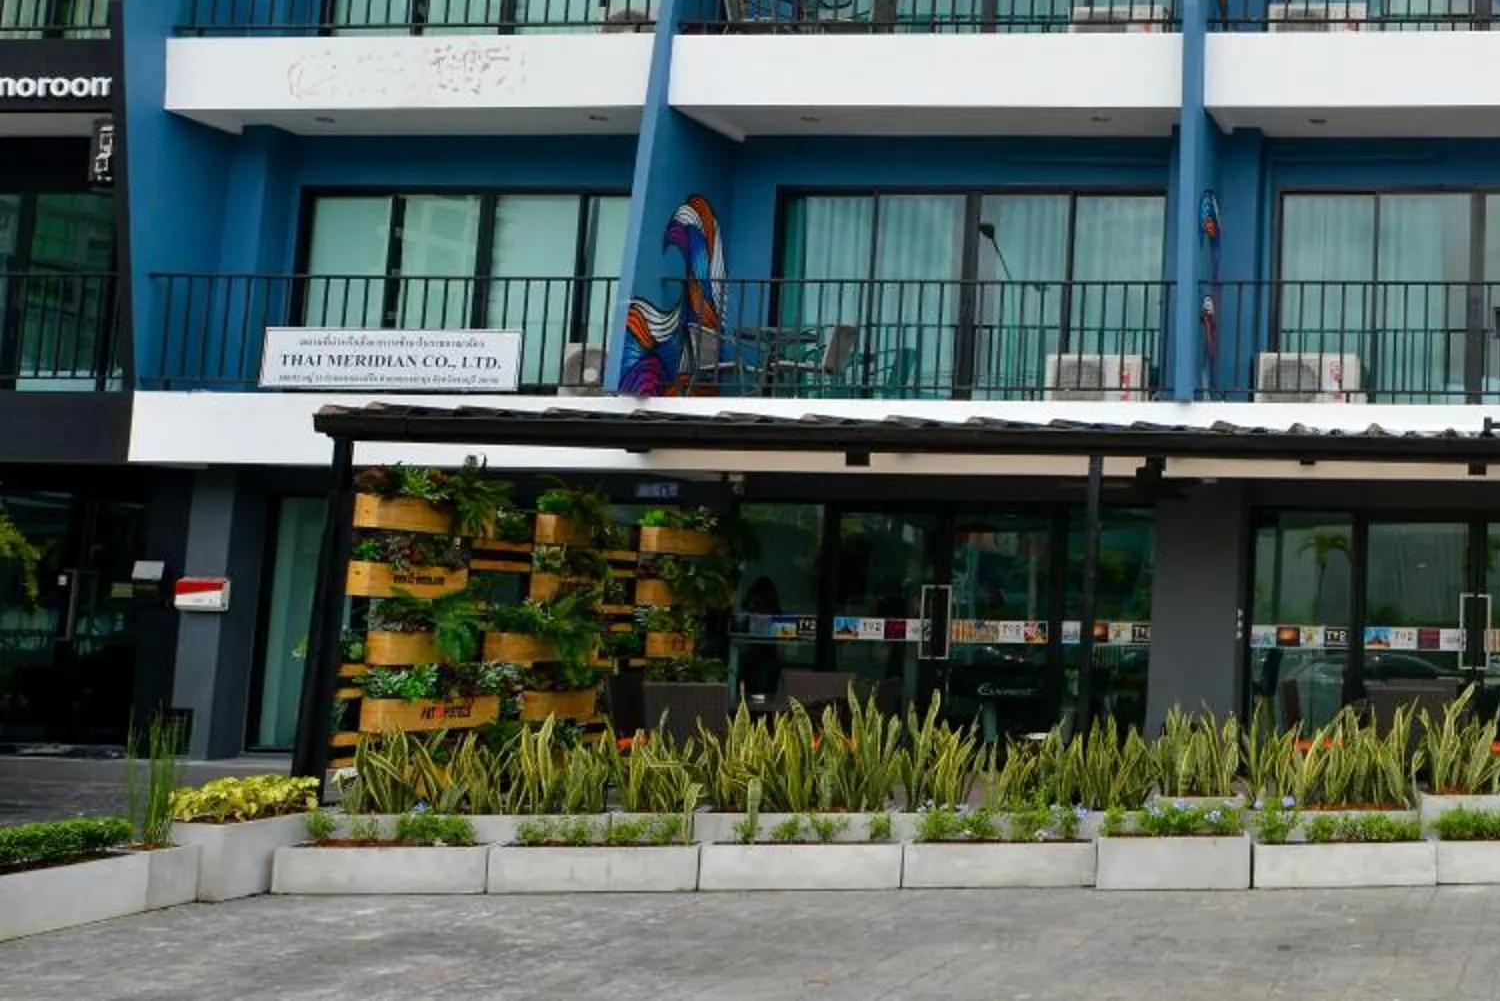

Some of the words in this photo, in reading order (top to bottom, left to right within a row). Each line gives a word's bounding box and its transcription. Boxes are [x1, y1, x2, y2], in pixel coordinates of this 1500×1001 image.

[280, 353, 323, 368] THAI
[327, 353, 418, 369] MERIDIAN
[422, 354, 457, 369] CO.,
[460, 355, 502, 370] LTD.
